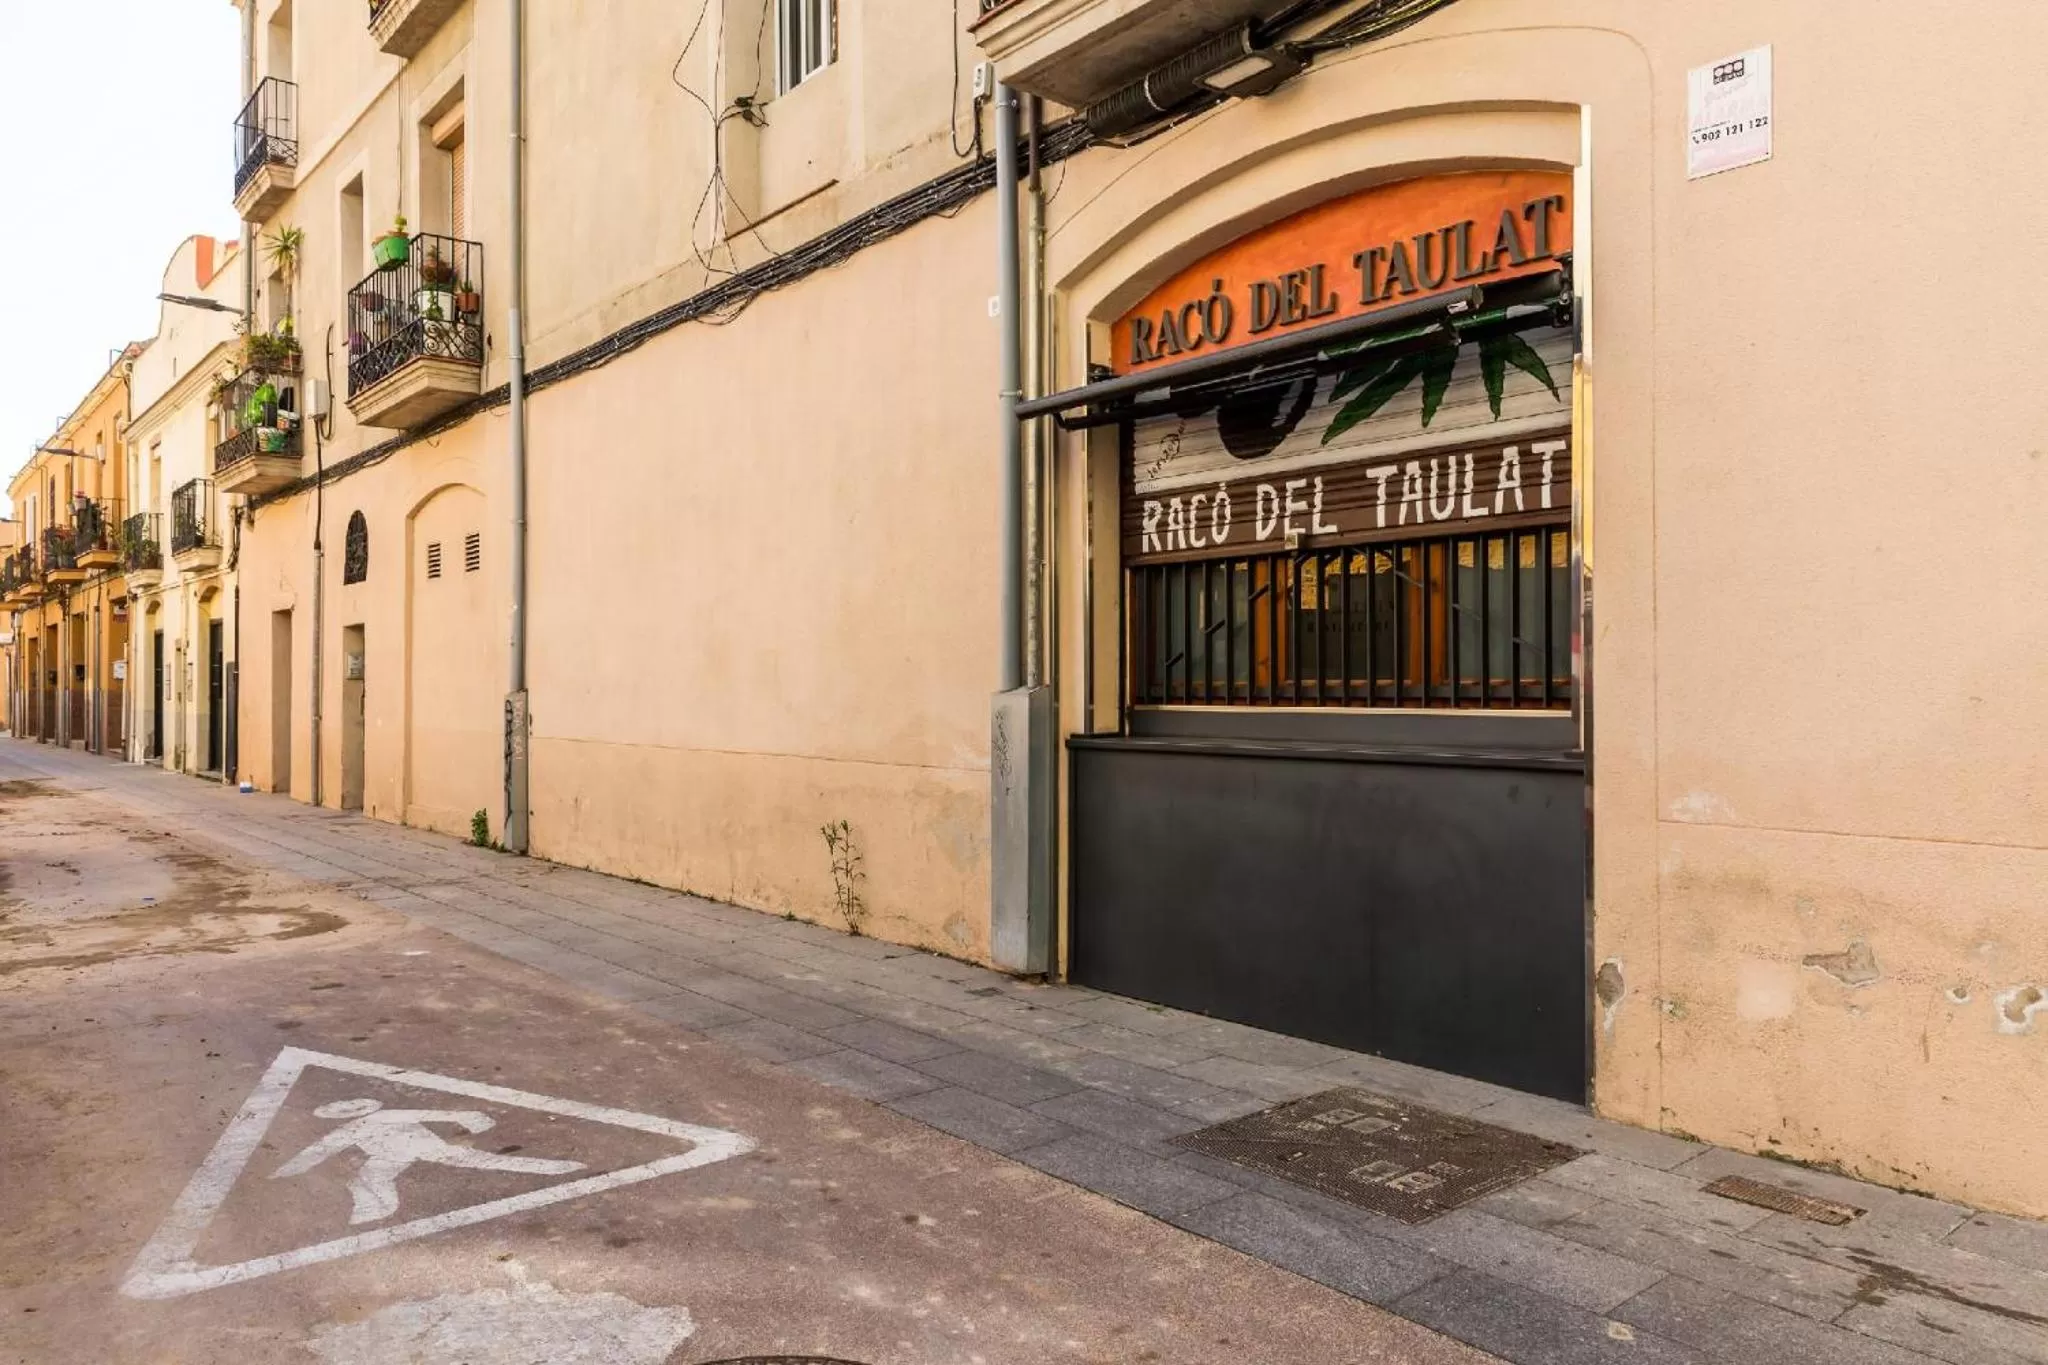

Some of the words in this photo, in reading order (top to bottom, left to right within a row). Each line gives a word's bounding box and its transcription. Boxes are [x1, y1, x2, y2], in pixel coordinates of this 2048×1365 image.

[1701, 130, 1721, 143] 902
[1726, 123, 1743, 136] 121
[1749, 116, 1768, 129] 122
[1130, 279, 1233, 365] RACÓ
[1248, 263, 1338, 335] DEL
[1353, 195, 1564, 305] TAULAT
[1255, 476, 1338, 543] DEL
[1366, 440, 1567, 528] TAULAT
